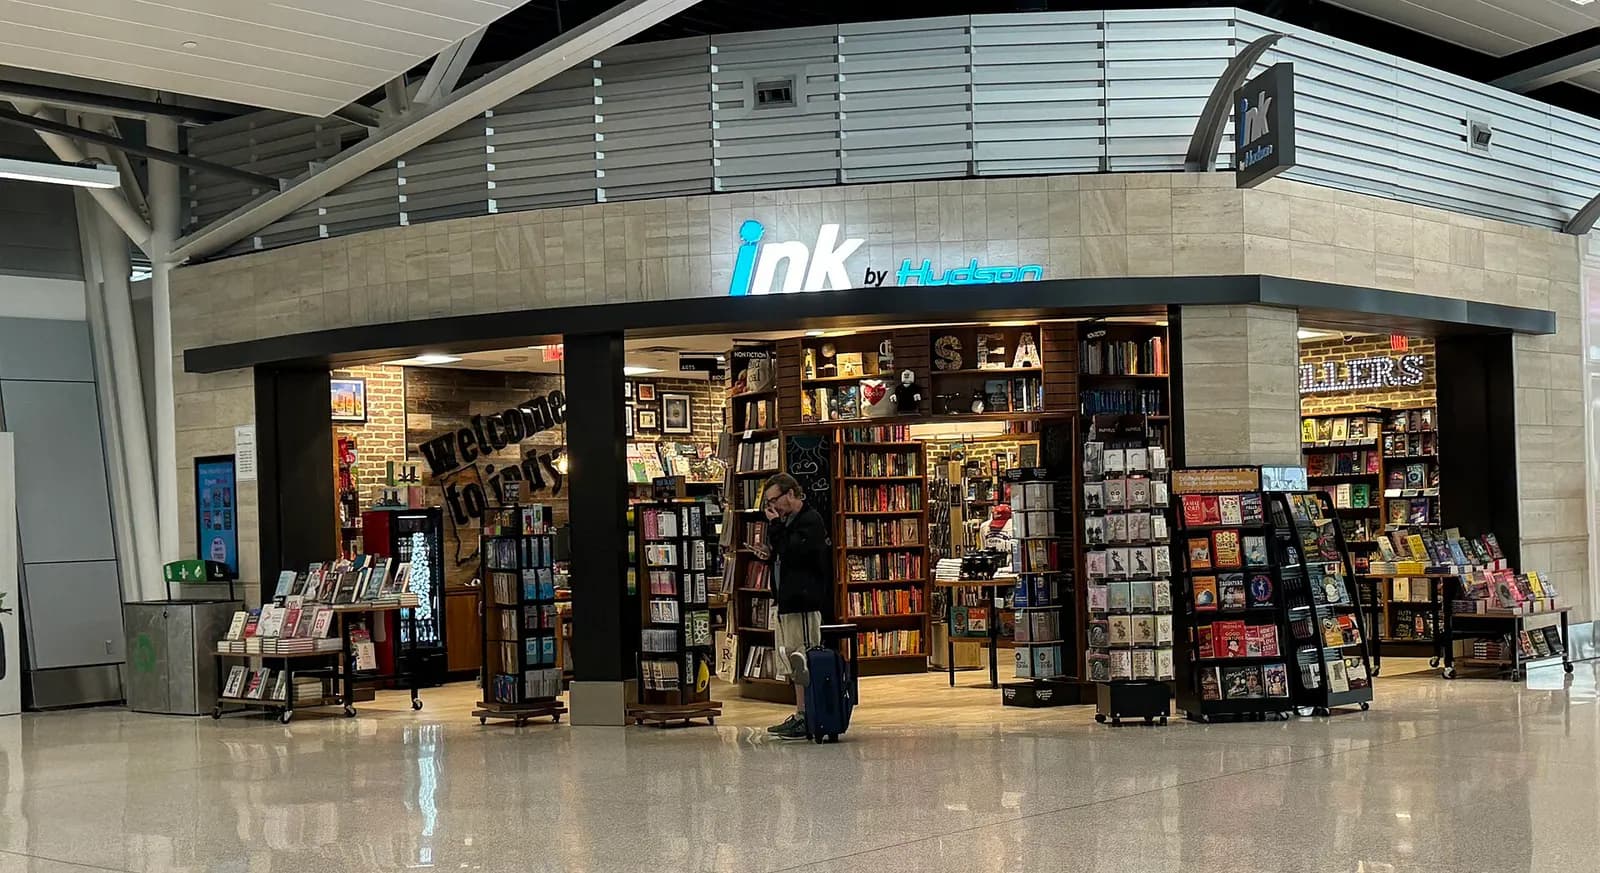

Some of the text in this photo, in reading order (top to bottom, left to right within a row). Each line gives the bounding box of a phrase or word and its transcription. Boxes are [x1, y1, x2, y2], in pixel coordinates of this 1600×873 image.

[1240, 90, 1273, 149] ink
[728, 219, 1043, 297] ink by Hudson
[1299, 354, 1425, 393] LLERS
[419, 390, 567, 477] Welcome
[446, 448, 563, 525] to indy
[1215, 531, 1237, 543] 888
